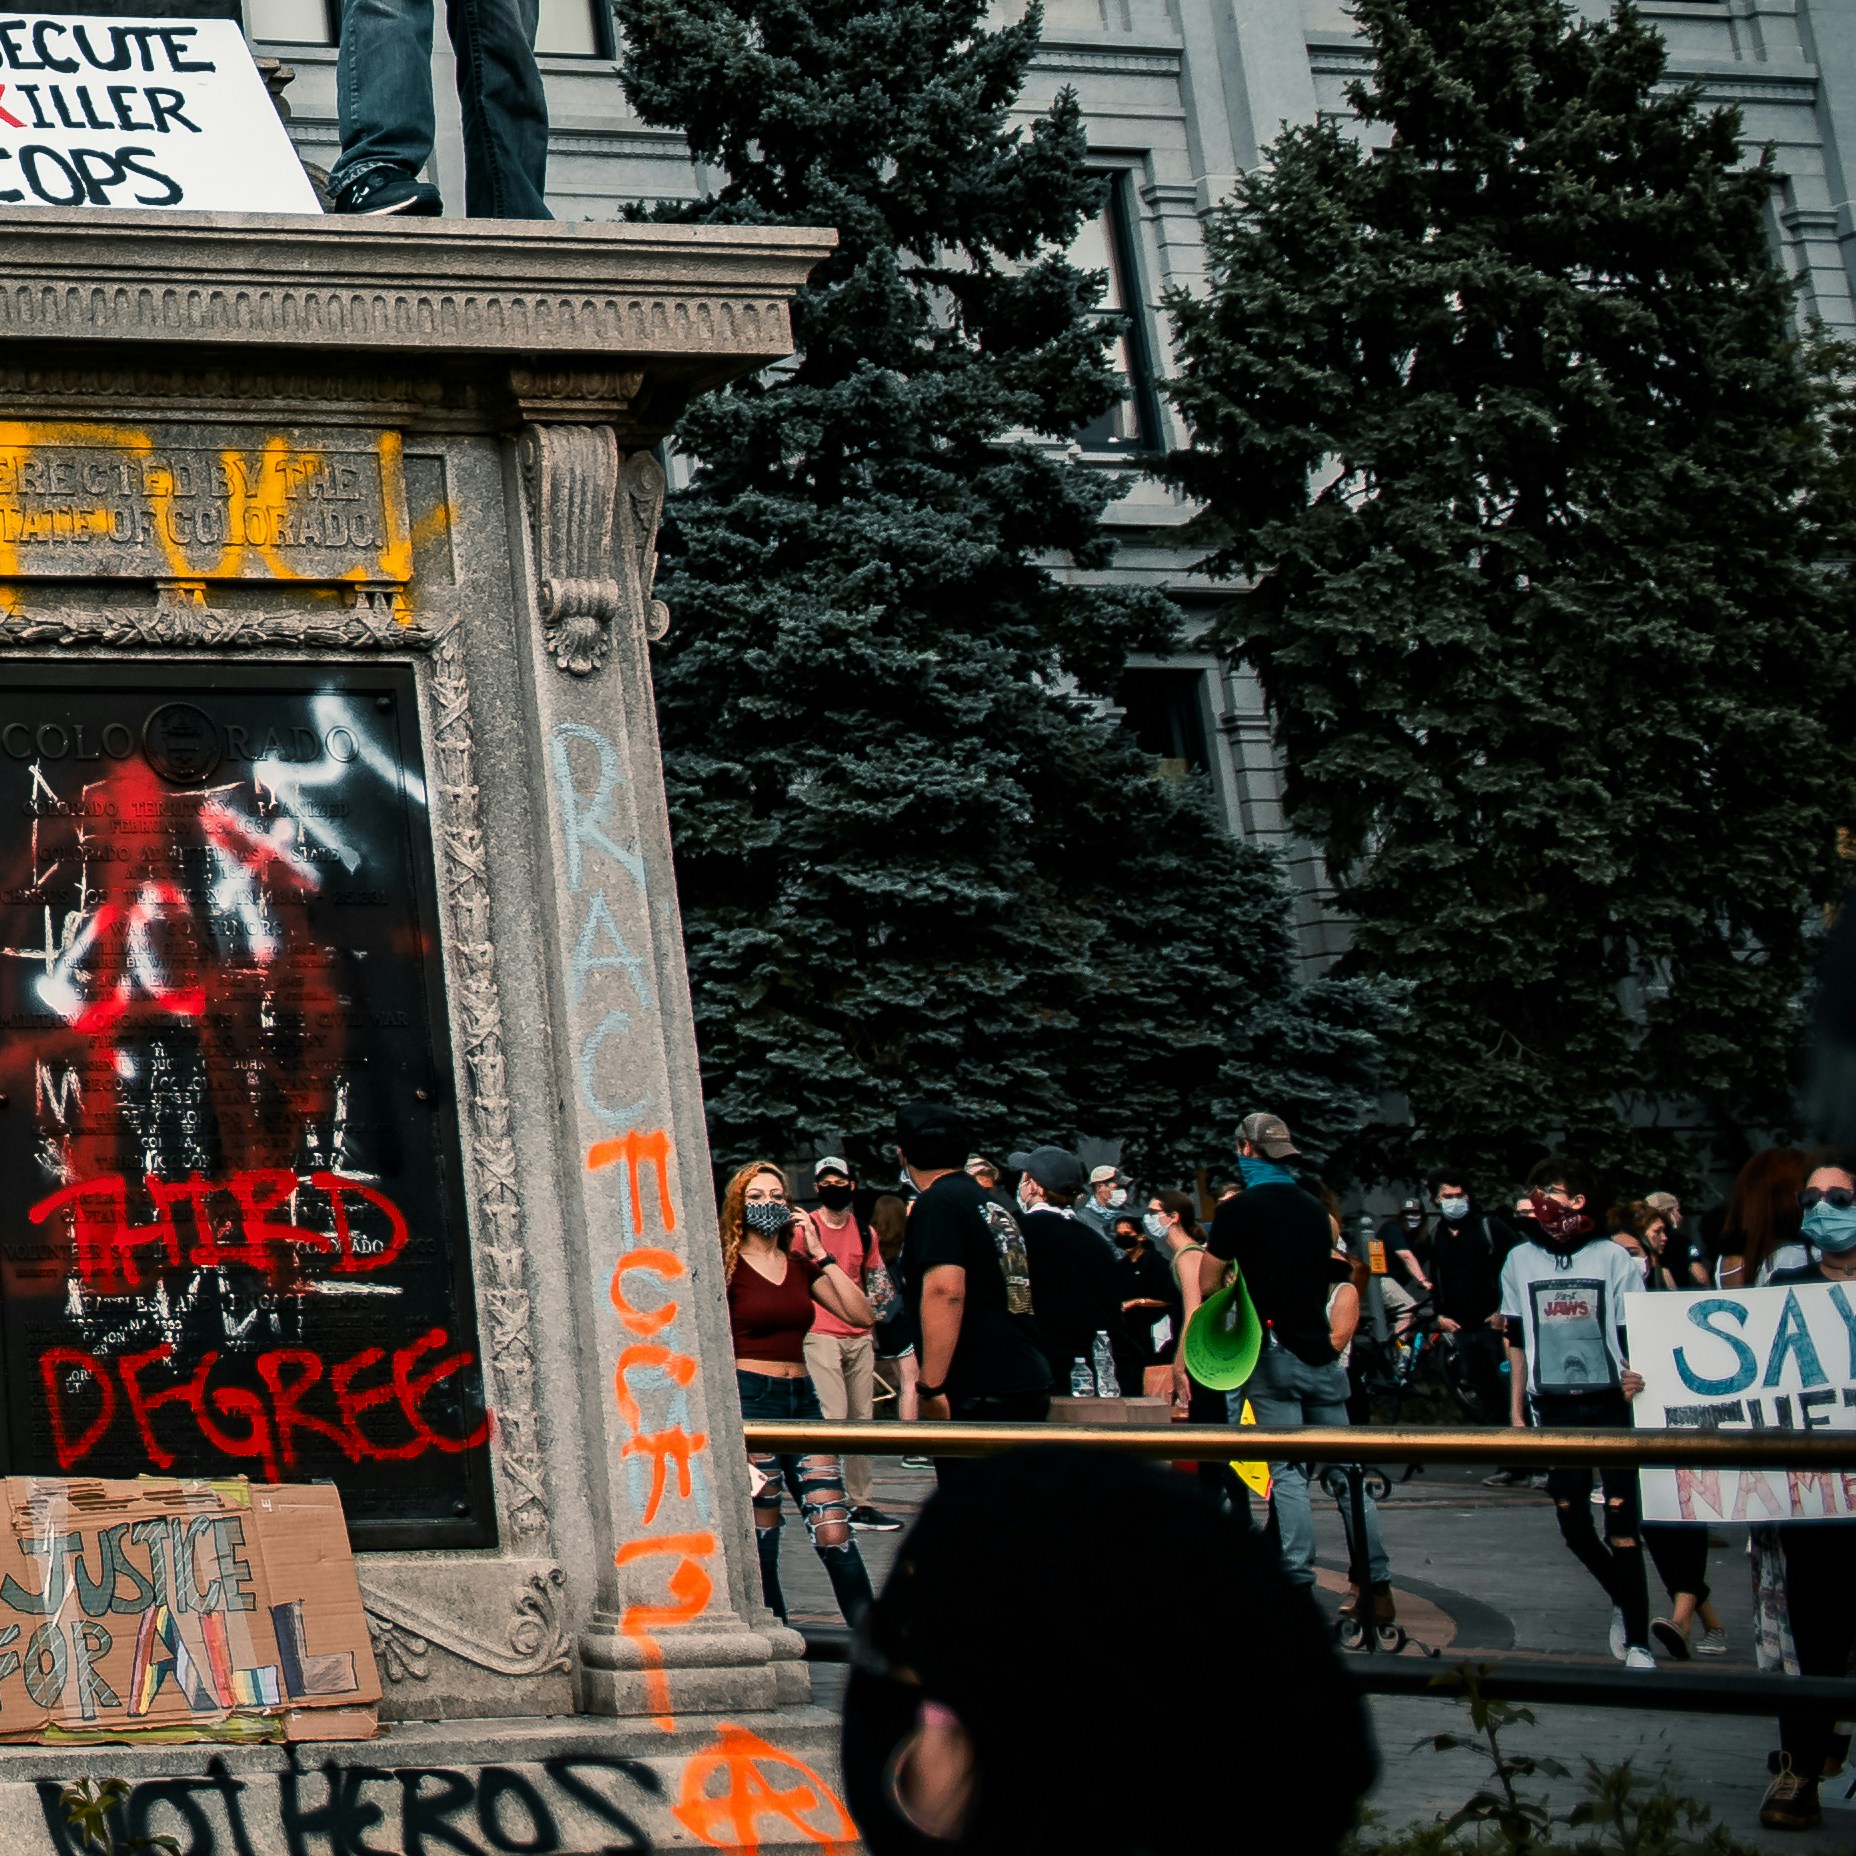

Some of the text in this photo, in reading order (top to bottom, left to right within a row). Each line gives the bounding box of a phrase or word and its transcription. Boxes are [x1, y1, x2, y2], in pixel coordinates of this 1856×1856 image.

[107, 504, 156, 546] OF
[209, 457, 264, 498] BY
[28, 1168, 409, 1285] THIRD
[1543, 1300, 1589, 1317] JAWS
[36, 1326, 497, 1485] DEGREE
[126, 1597, 360, 1718] ALL
[280, 1745, 664, 1856] HEROS
